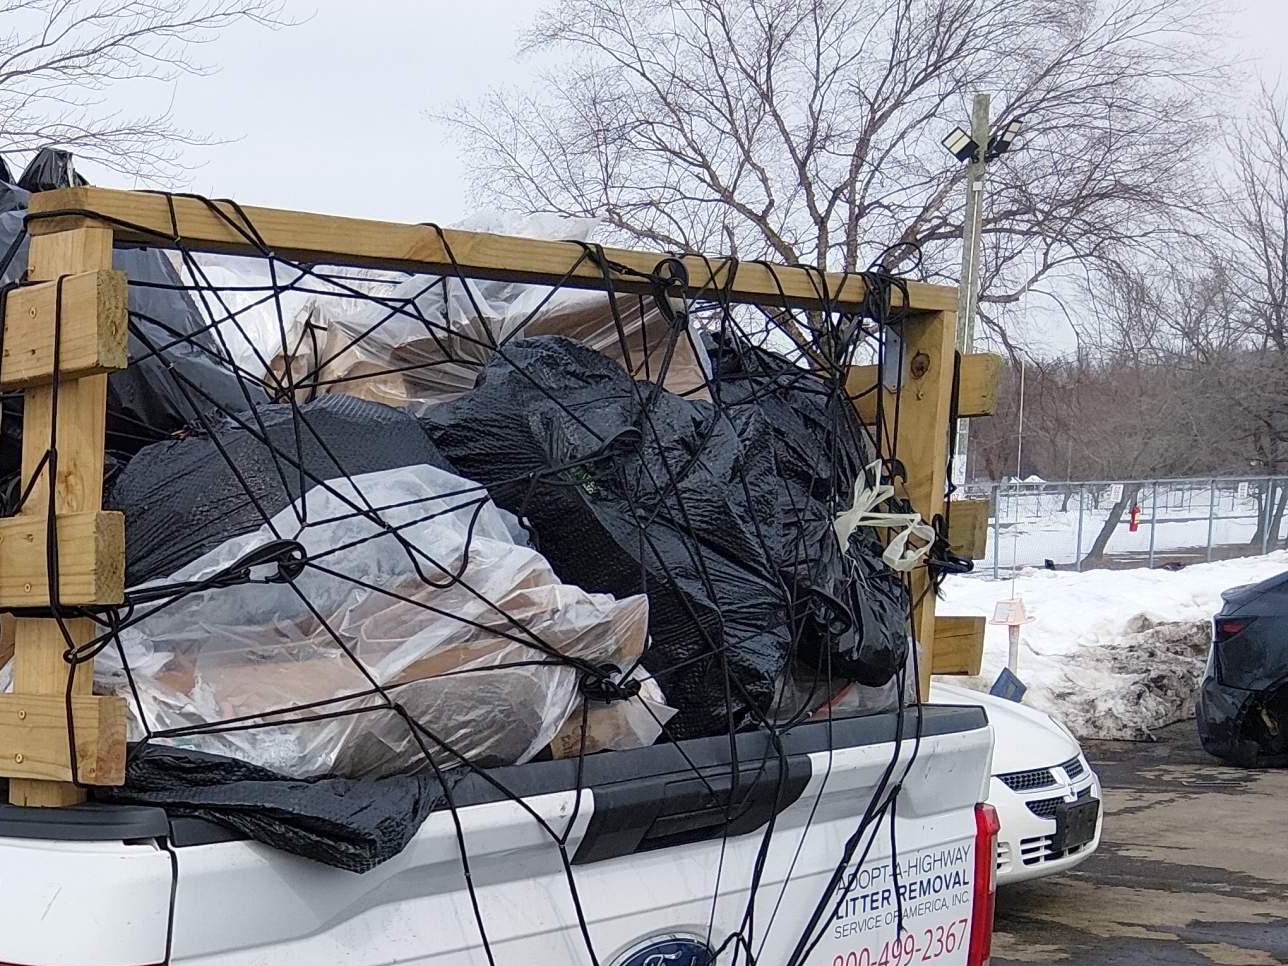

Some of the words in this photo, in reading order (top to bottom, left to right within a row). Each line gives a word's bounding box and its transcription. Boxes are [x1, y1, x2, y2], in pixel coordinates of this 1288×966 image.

[836, 844, 971, 895] ADOPT-A-HIGHWAY
[836, 888, 892, 920] LITTER
[898, 868, 970, 902] REMOVAL
[834, 914, 883, 939] SERVICE
